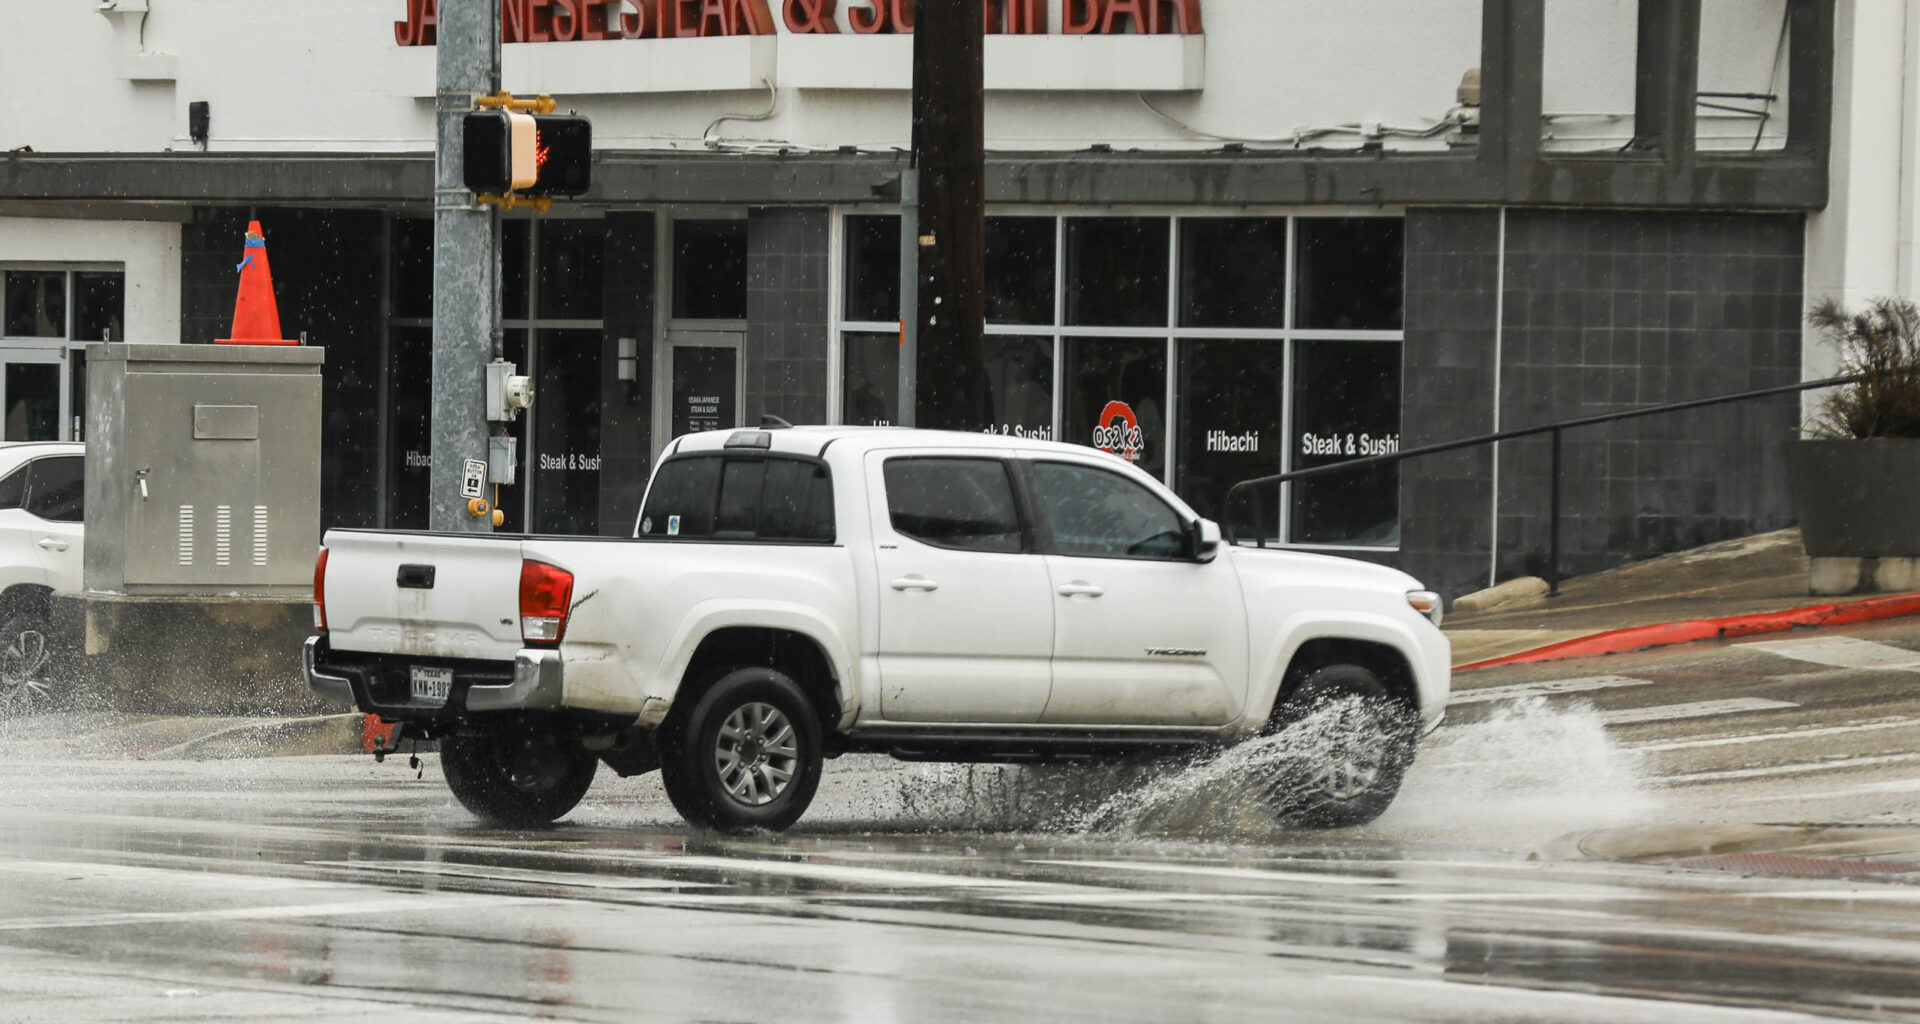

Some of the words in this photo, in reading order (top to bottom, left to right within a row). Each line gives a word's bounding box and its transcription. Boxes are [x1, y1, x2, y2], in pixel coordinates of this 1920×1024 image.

[1015, 423, 1051, 441] Sushi
[1207, 430, 1259, 452] Hibachi
[1303, 432, 1342, 455] Steak
[1345, 433, 1356, 455] &
[1360, 433, 1399, 456] Sushi
[406, 450, 431, 467] Hibac
[540, 453, 567, 470] Steak
[569, 453, 577, 470] &
[578, 453, 601, 470] Sush
